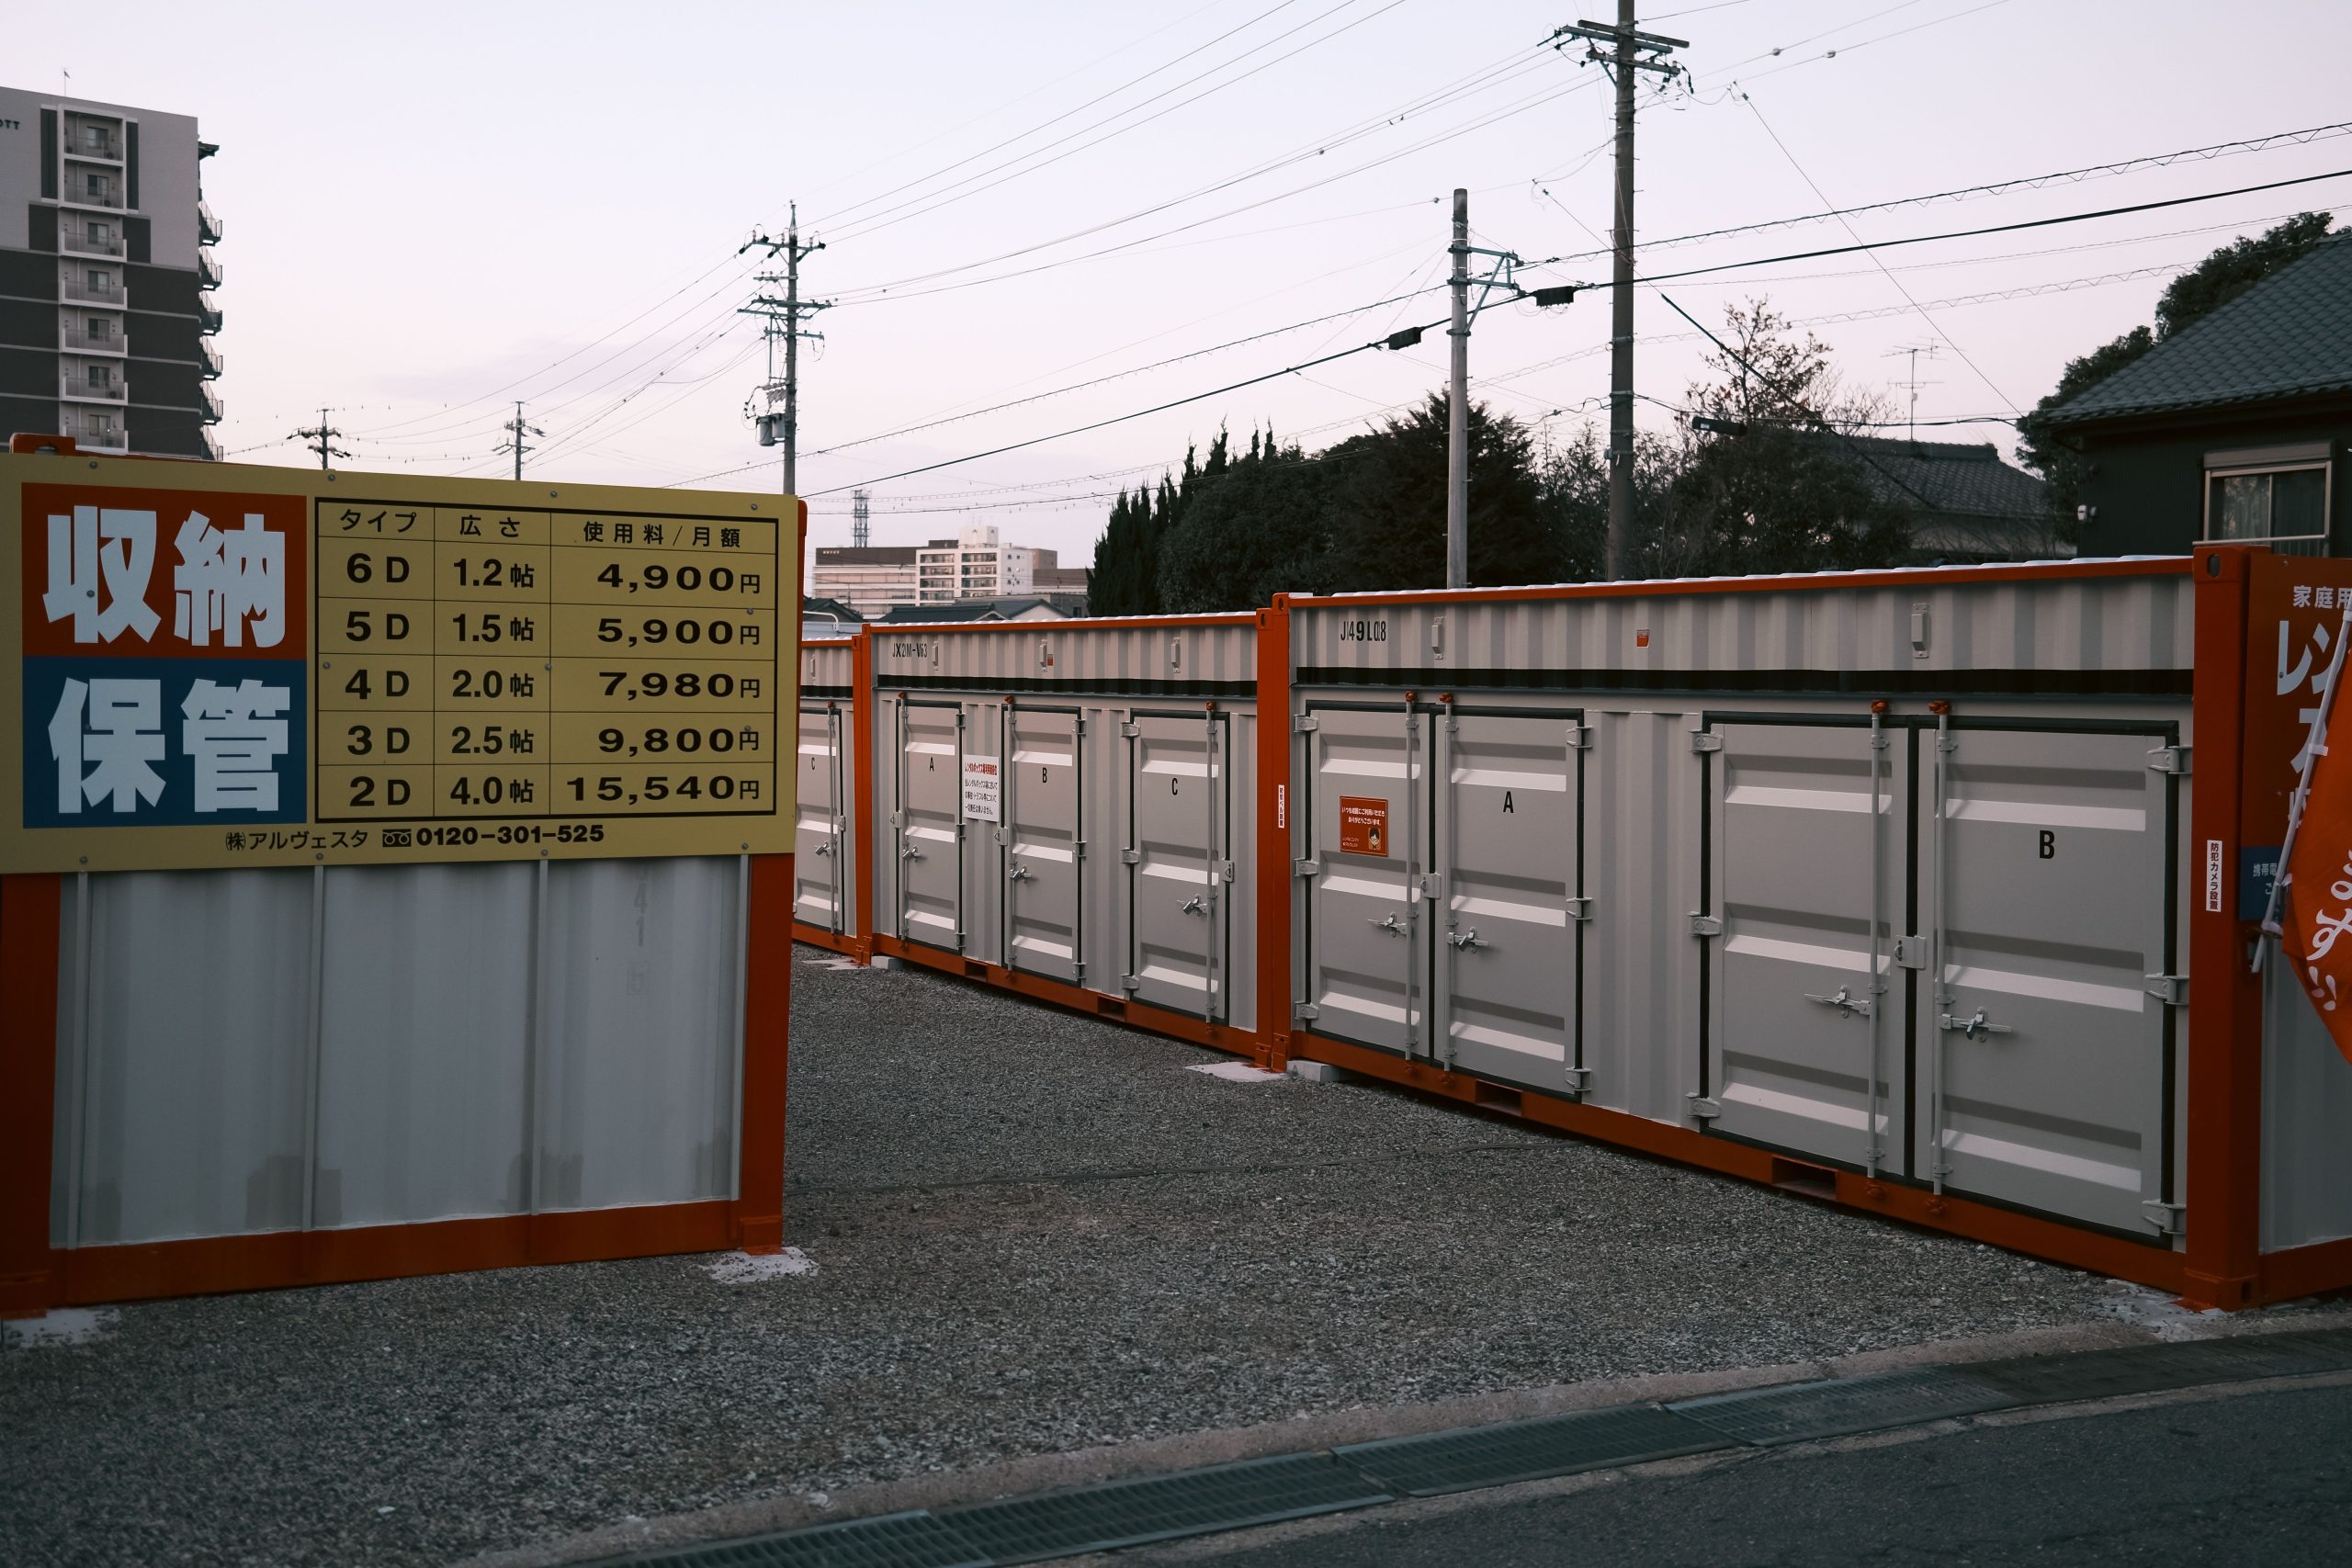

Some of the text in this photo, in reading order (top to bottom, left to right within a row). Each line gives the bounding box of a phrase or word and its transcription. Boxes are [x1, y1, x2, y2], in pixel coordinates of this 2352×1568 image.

[340, 509, 416, 533] タイプ
[459, 514, 520, 537] 広さ
[42, 505, 285, 648] 収納
[347, 553, 410, 583] 6D
[453, 558, 535, 588] 1.2帖
[597, 564, 761, 593] 4,900円
[2293, 585, 2352, 609] 家庭用
[345, 611, 410, 641] 5D
[453, 614, 535, 642] 1.5帖
[597, 618, 760, 648] 5,900円
[345, 670, 410, 699] 4D
[452, 670, 534, 698] 2.0帖
[599, 672, 760, 701] 7,980円
[48, 677, 290, 814] 保管
[347, 725, 411, 755] 3D
[451, 726, 534, 754] 2.5帖
[598, 728, 759, 757] 9,800円
[810, 757, 816, 771] C
[929, 757, 934, 772] A
[1042, 767, 1047, 784] B
[349, 776, 411, 807] 2D
[450, 776, 534, 805] 4.0帖
[567, 775, 759, 806] 15,540円
[1171, 777, 1179, 795] C
[1502, 791, 1514, 814] A
[416, 824, 605, 846] 0120-301-525
[2039, 830, 2055, 859] B
[2210, 842, 2219, 909] 防犯カメラ設置
